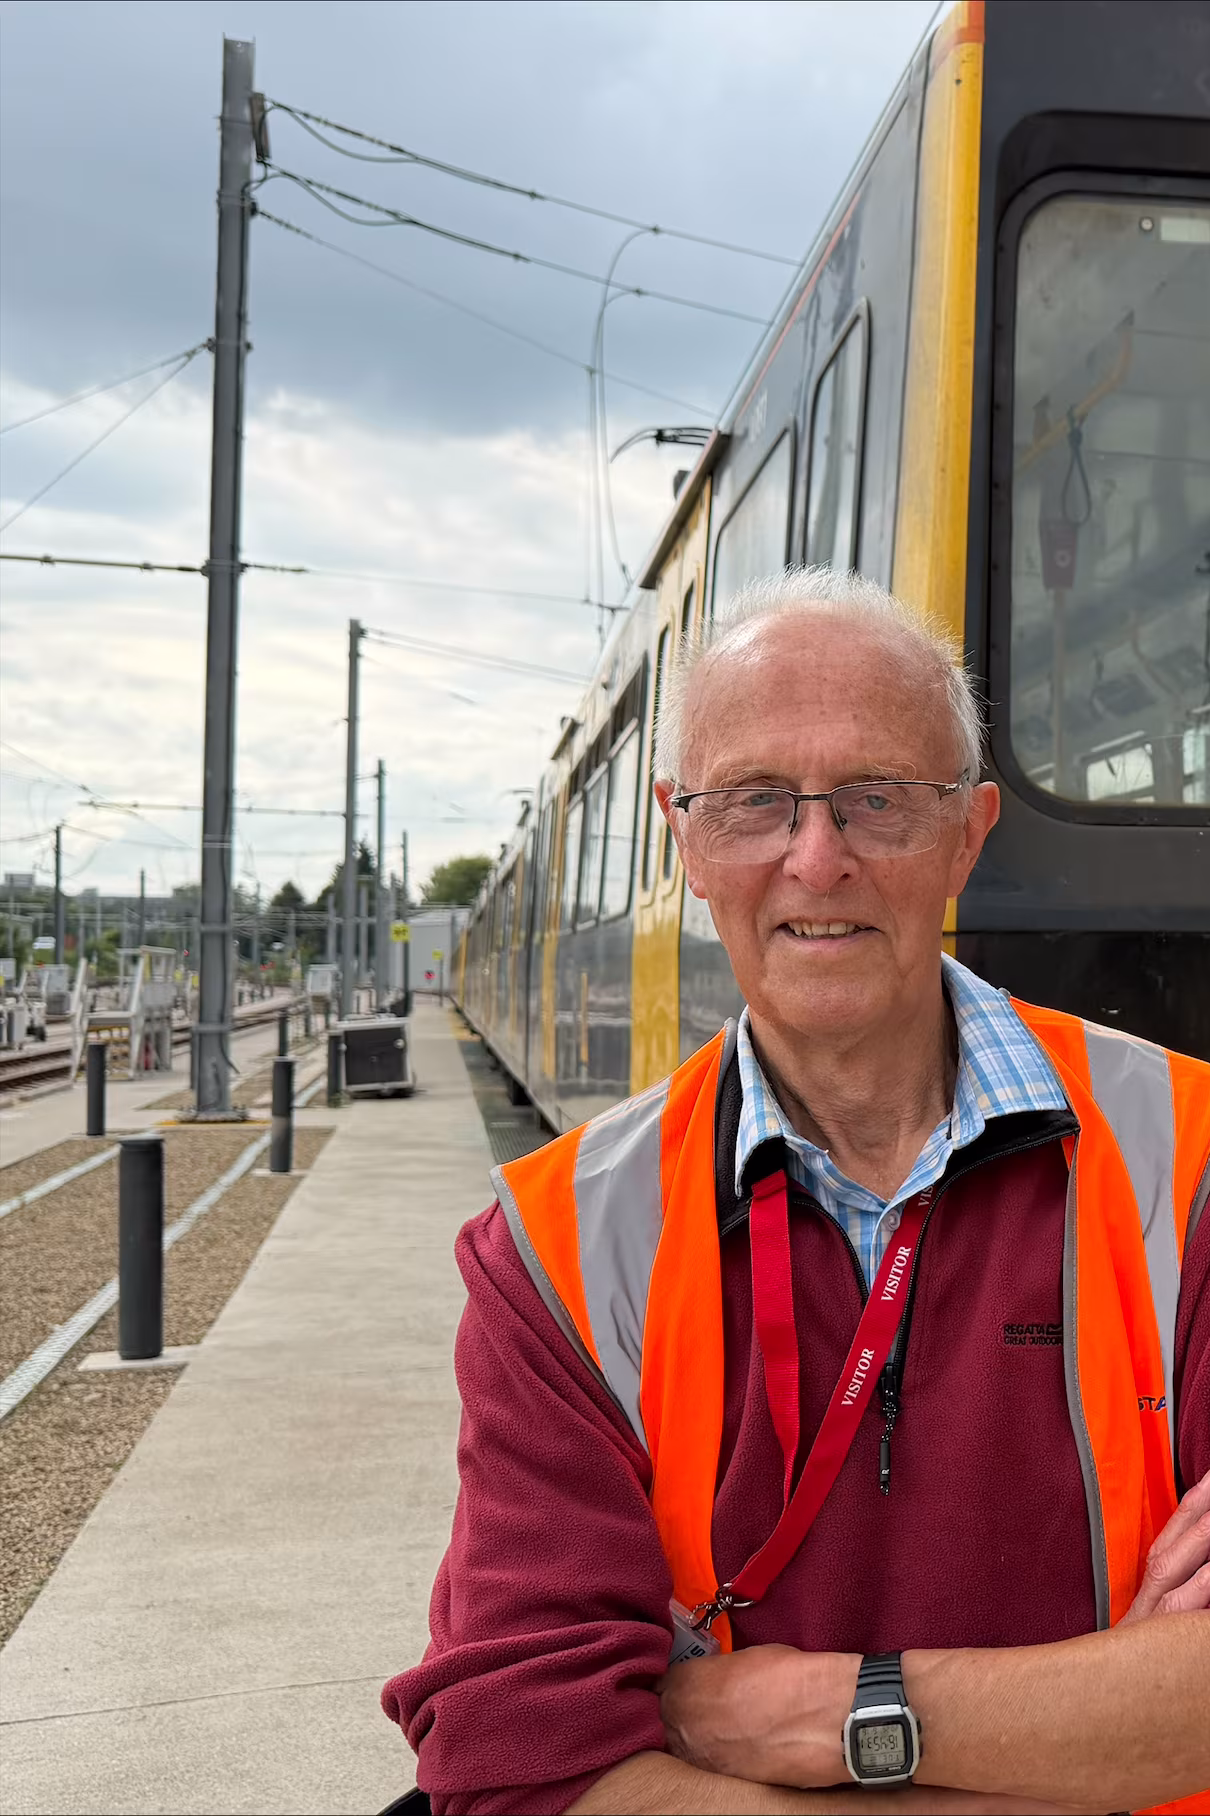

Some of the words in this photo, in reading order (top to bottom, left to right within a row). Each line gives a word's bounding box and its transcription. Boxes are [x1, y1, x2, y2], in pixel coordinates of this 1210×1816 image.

[880, 1246, 912, 1301] VISITOR
[1004, 1324, 1045, 1335] REGATTA
[841, 1348, 875, 1406] VISITOR
